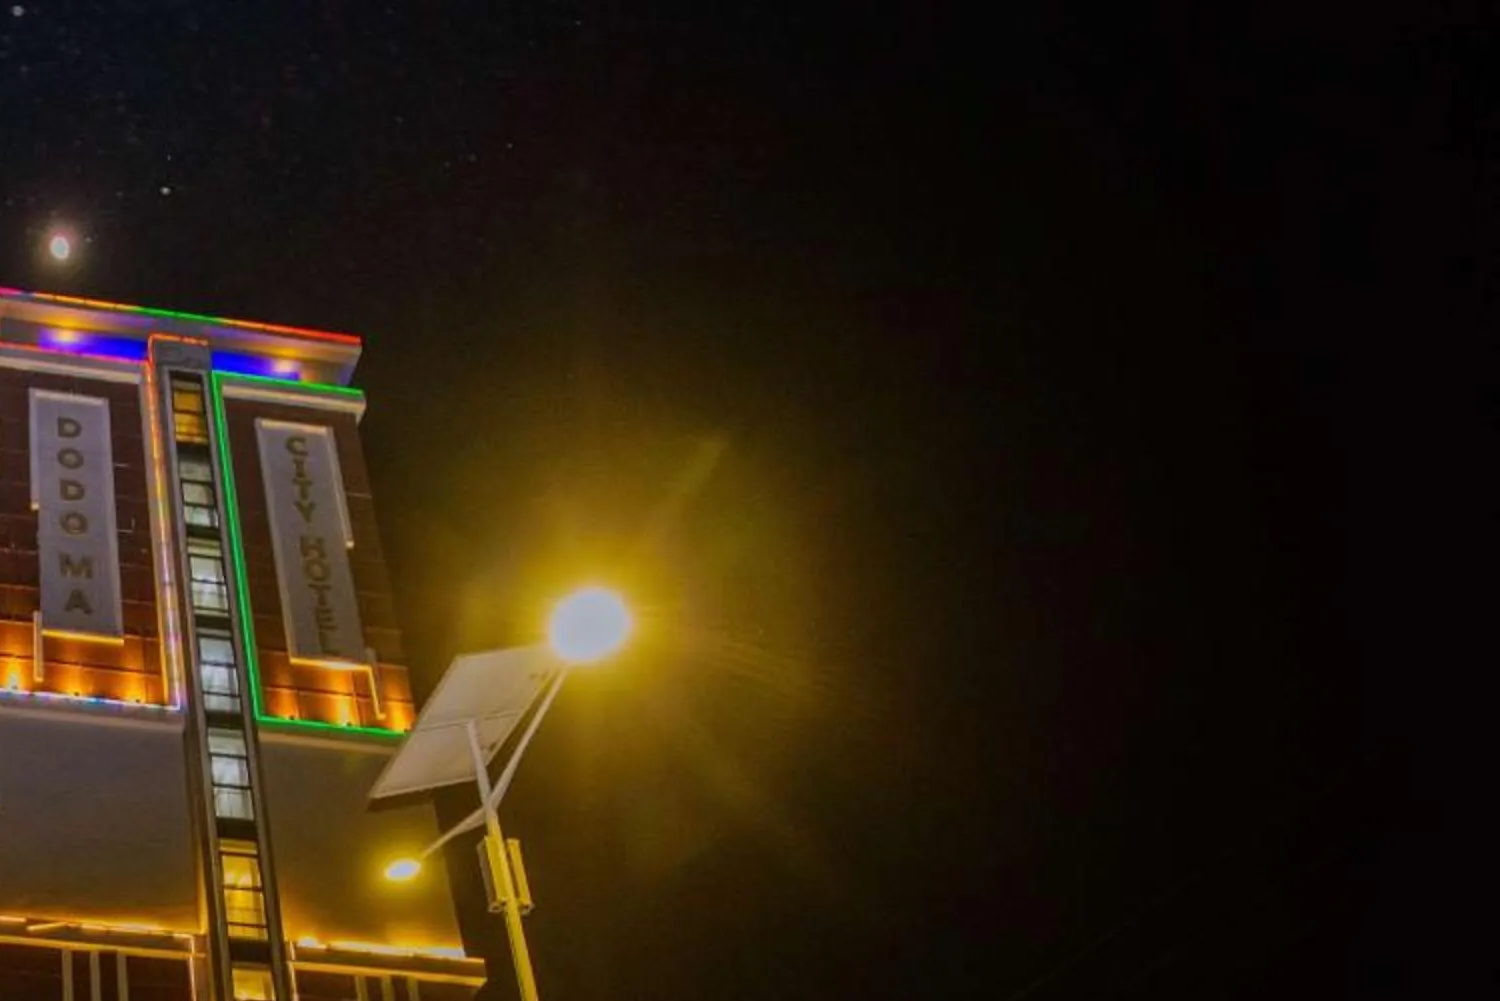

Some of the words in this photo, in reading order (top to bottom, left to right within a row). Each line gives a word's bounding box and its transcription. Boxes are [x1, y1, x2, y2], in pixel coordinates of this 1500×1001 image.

[57, 416, 93, 616] DODOMA
[285, 436, 315, 524] CITY
[301, 536, 341, 657] HOTEL
